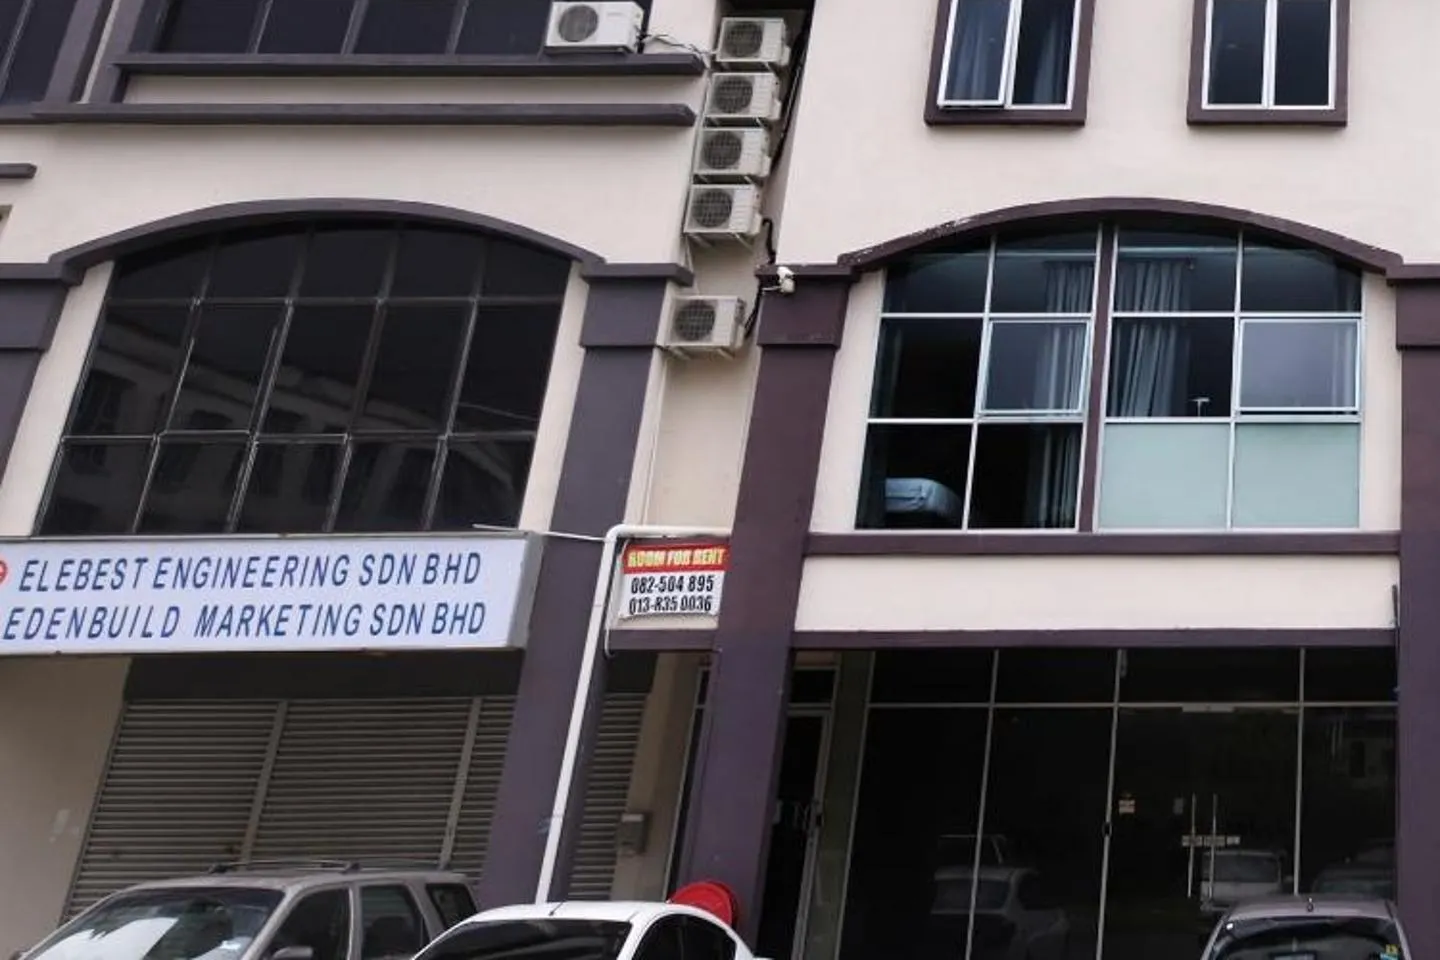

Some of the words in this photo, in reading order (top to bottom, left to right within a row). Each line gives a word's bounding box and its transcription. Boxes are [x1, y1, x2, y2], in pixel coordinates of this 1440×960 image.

[18, 557, 147, 592] ELEBEST
[152, 554, 351, 591] ENGINEERING
[358, 553, 416, 587] SDN
[422, 551, 482, 585] BHD
[687, 574, 716, 593] 895
[3, 605, 181, 640] EDENBUILD
[193, 603, 362, 639] MARKETING
[368, 602, 426, 637] SDN
[431, 601, 487, 635] BHD
